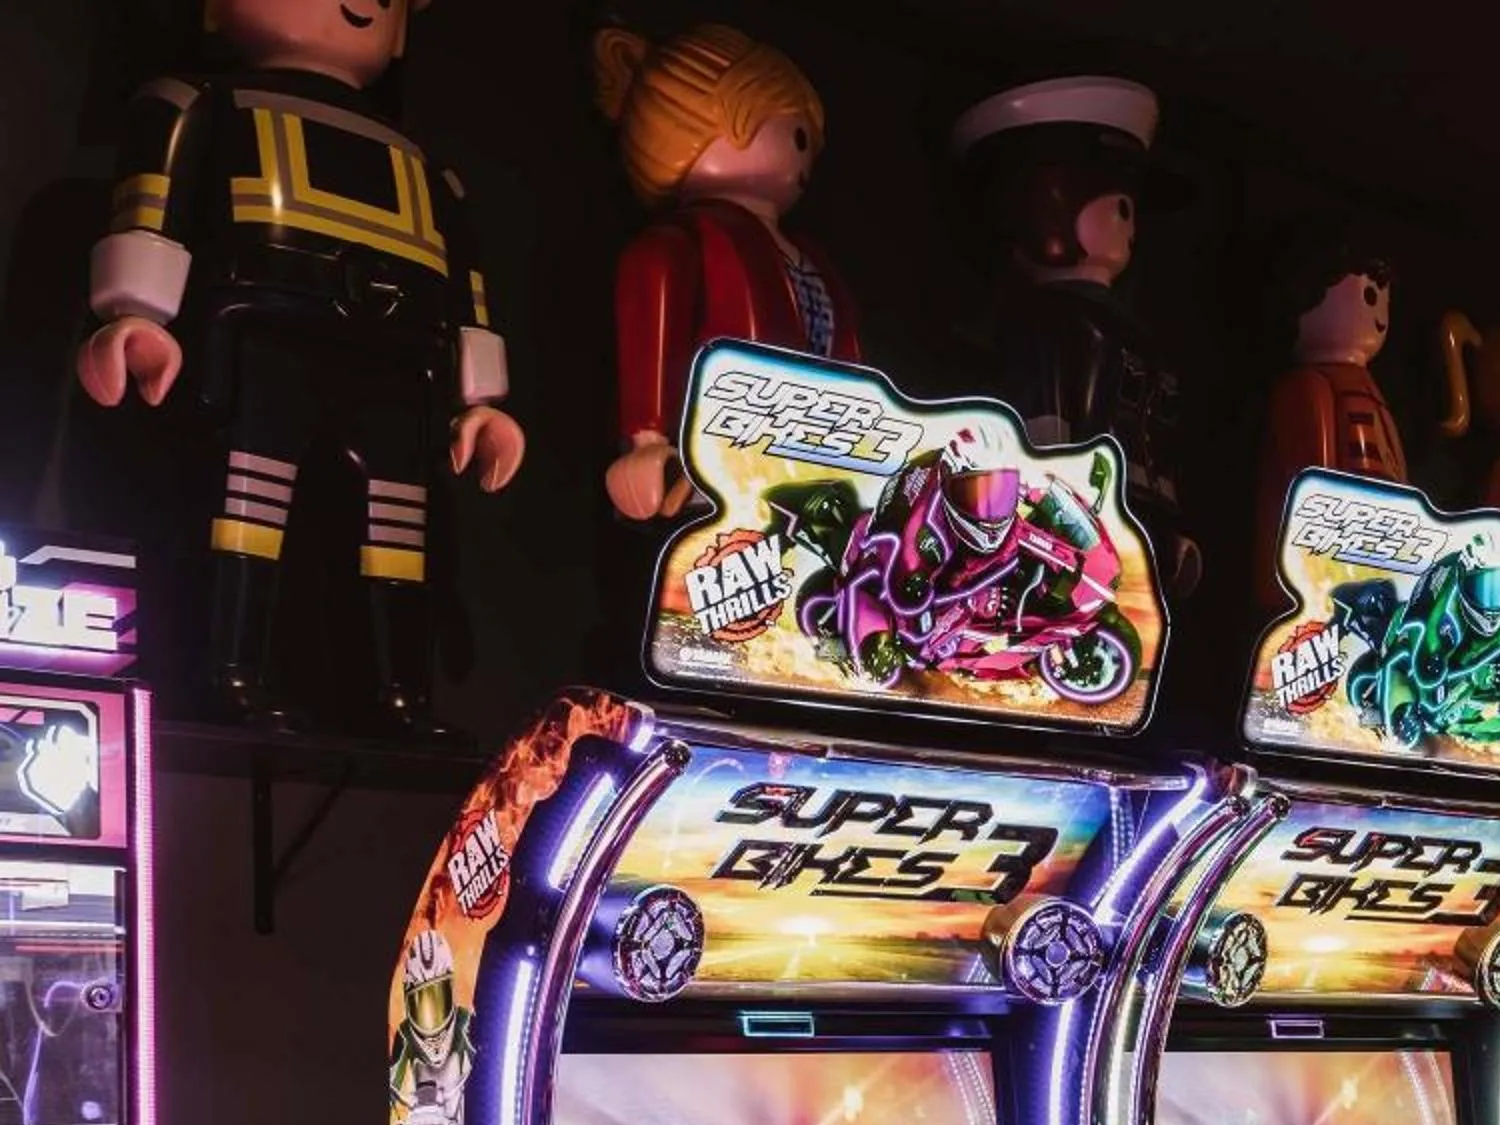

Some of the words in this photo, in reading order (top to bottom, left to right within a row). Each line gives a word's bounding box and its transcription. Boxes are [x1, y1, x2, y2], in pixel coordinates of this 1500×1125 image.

[704, 372, 884, 430] SUPER
[703, 406, 864, 456] BIKES
[858, 418, 925, 476] 3
[1292, 522, 1406, 560] BIKES
[1295, 494, 1421, 538] SUPER
[685, 534, 782, 613] RAW
[694, 572, 792, 635] THRILLS
[1271, 624, 1339, 689] RAW
[1277, 657, 1346, 708] THRILLS
[716, 782, 994, 845] SUPER
[448, 808, 501, 896] RAW
[458, 845, 510, 915] THRILLS
[711, 839, 960, 890] BIKES
[975, 822, 1059, 905] 3
[1280, 827, 1482, 877] SUPER
[1275, 872, 1456, 915] BIKES
